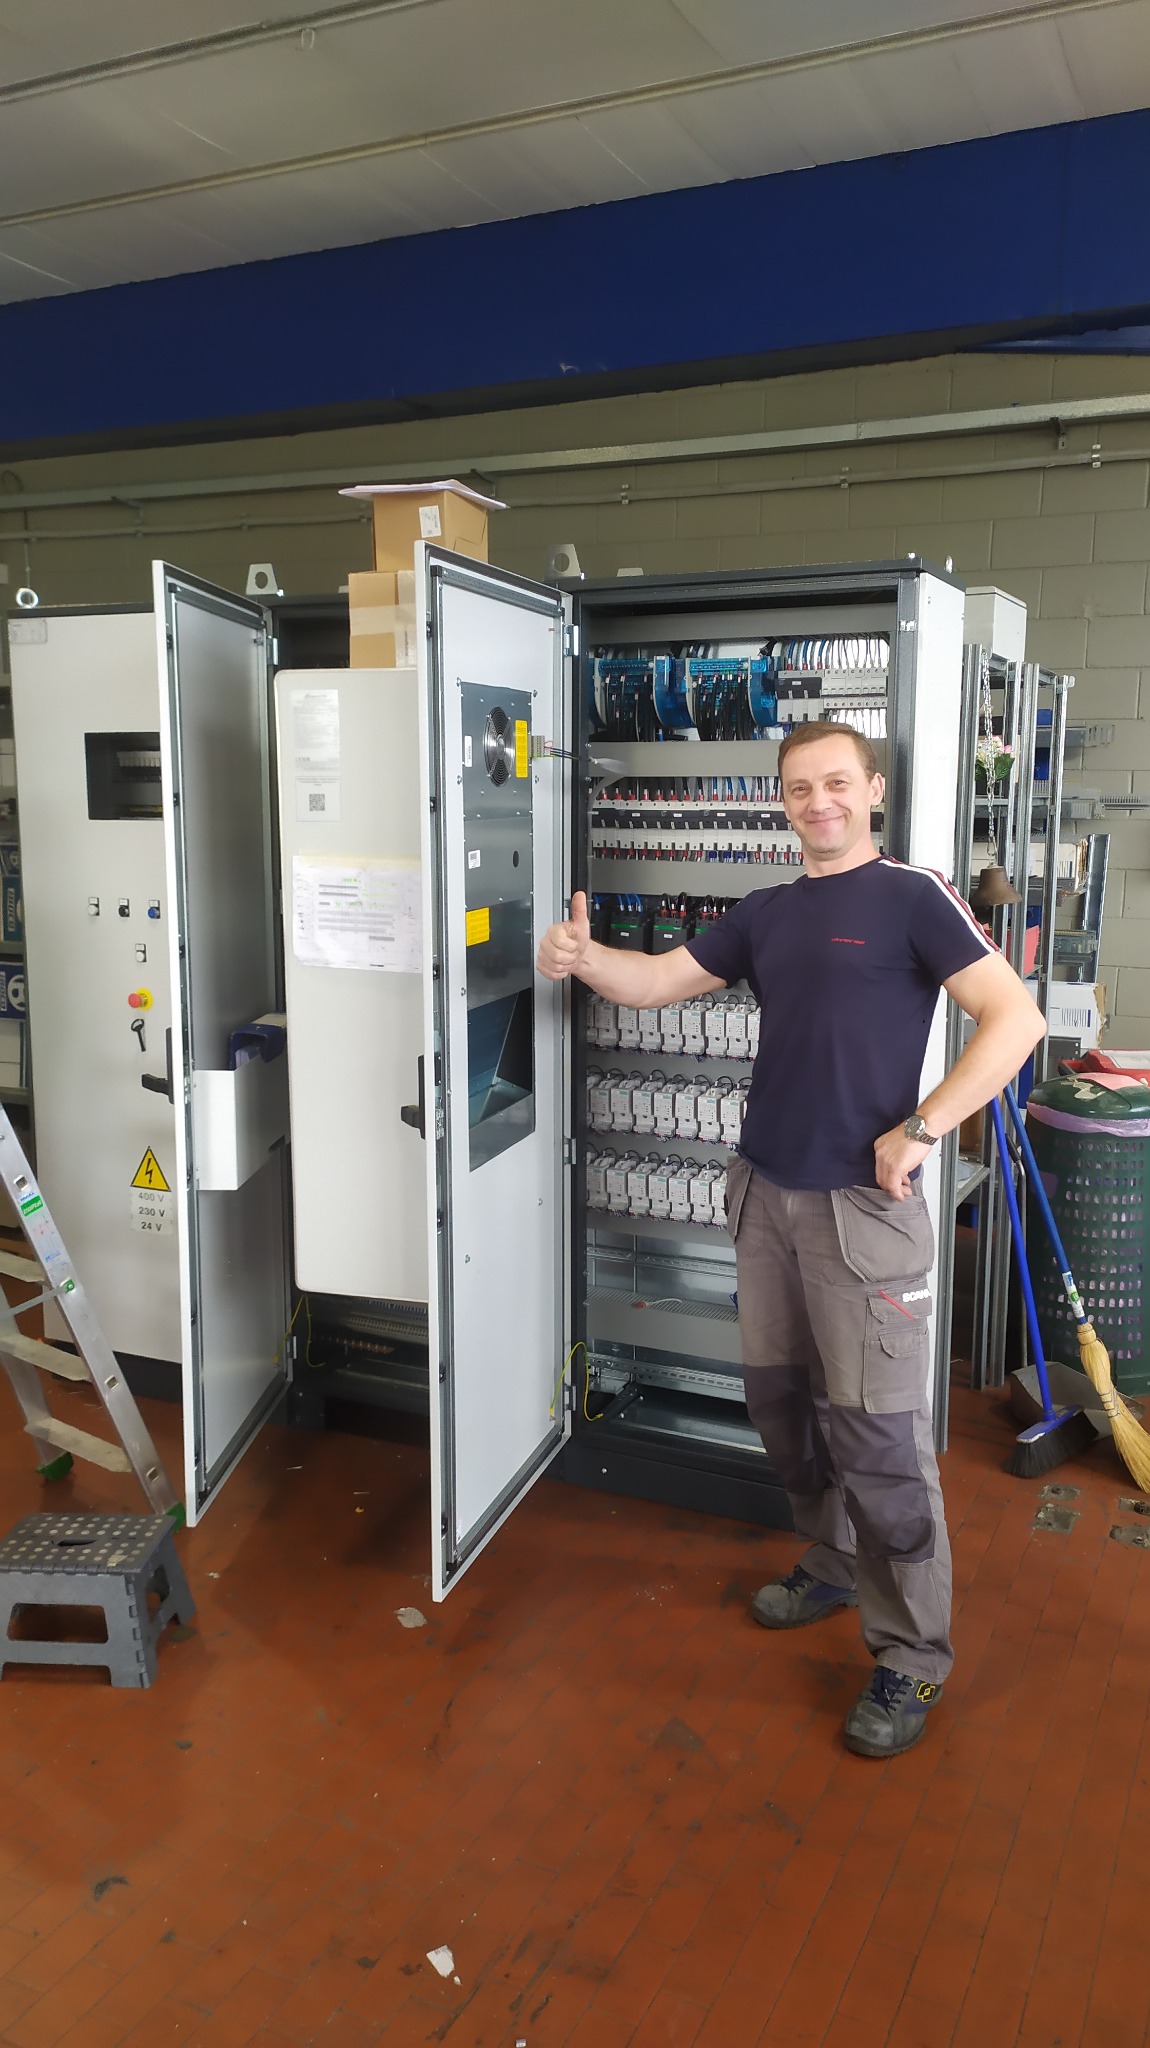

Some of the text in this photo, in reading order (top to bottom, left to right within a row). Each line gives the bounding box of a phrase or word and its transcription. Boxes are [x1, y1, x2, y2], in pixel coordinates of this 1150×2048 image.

[138, 1192, 164, 1202] 400 V
[138, 1206, 165, 1217] 230 V
[141, 1221, 162, 1231] 24 V
